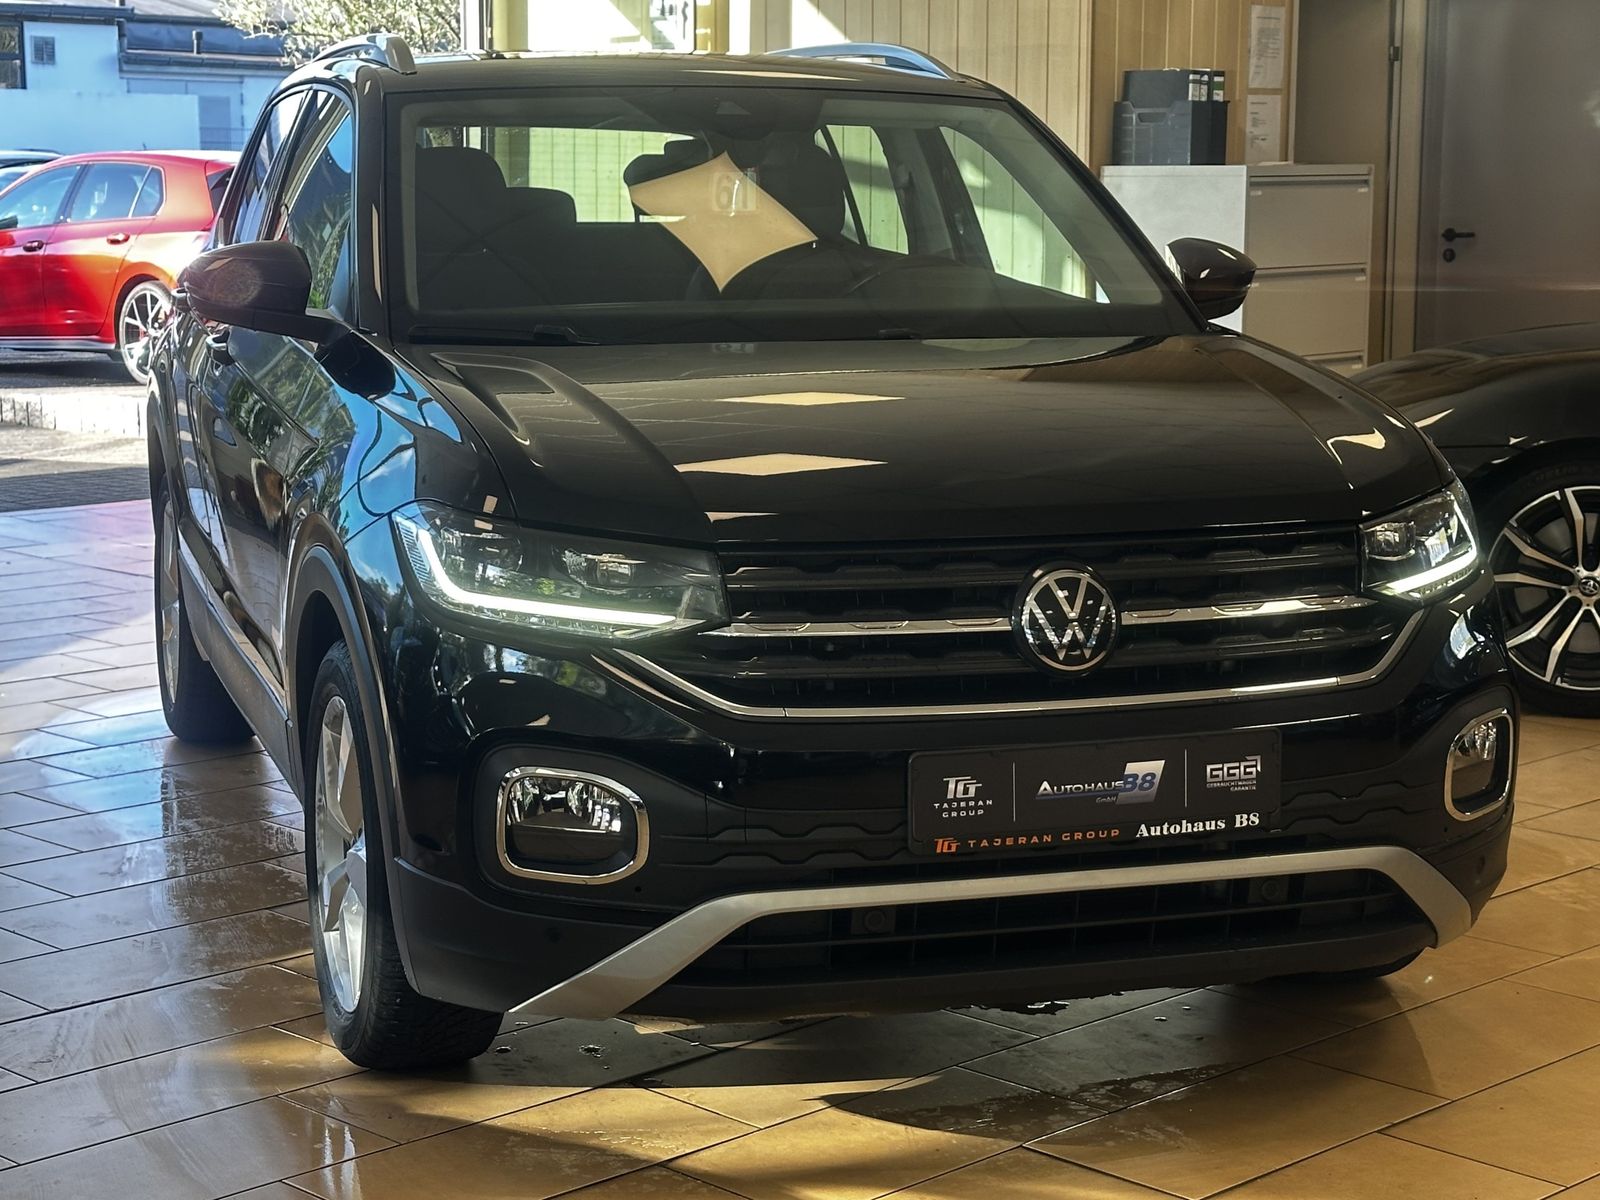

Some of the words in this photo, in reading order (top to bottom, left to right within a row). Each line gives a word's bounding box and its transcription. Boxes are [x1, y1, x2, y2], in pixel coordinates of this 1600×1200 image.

[1206, 760, 1257, 783] GGG
[943, 776, 983, 799] TG
[933, 799, 993, 809] TAJERAN
[942, 809, 984, 818] GROUP
[1136, 820, 1226, 838] Autohaus
[1234, 812, 1260, 829] B8
[968, 834, 1052, 848] TAJERAN
[1062, 828, 1121, 841] GROUP
